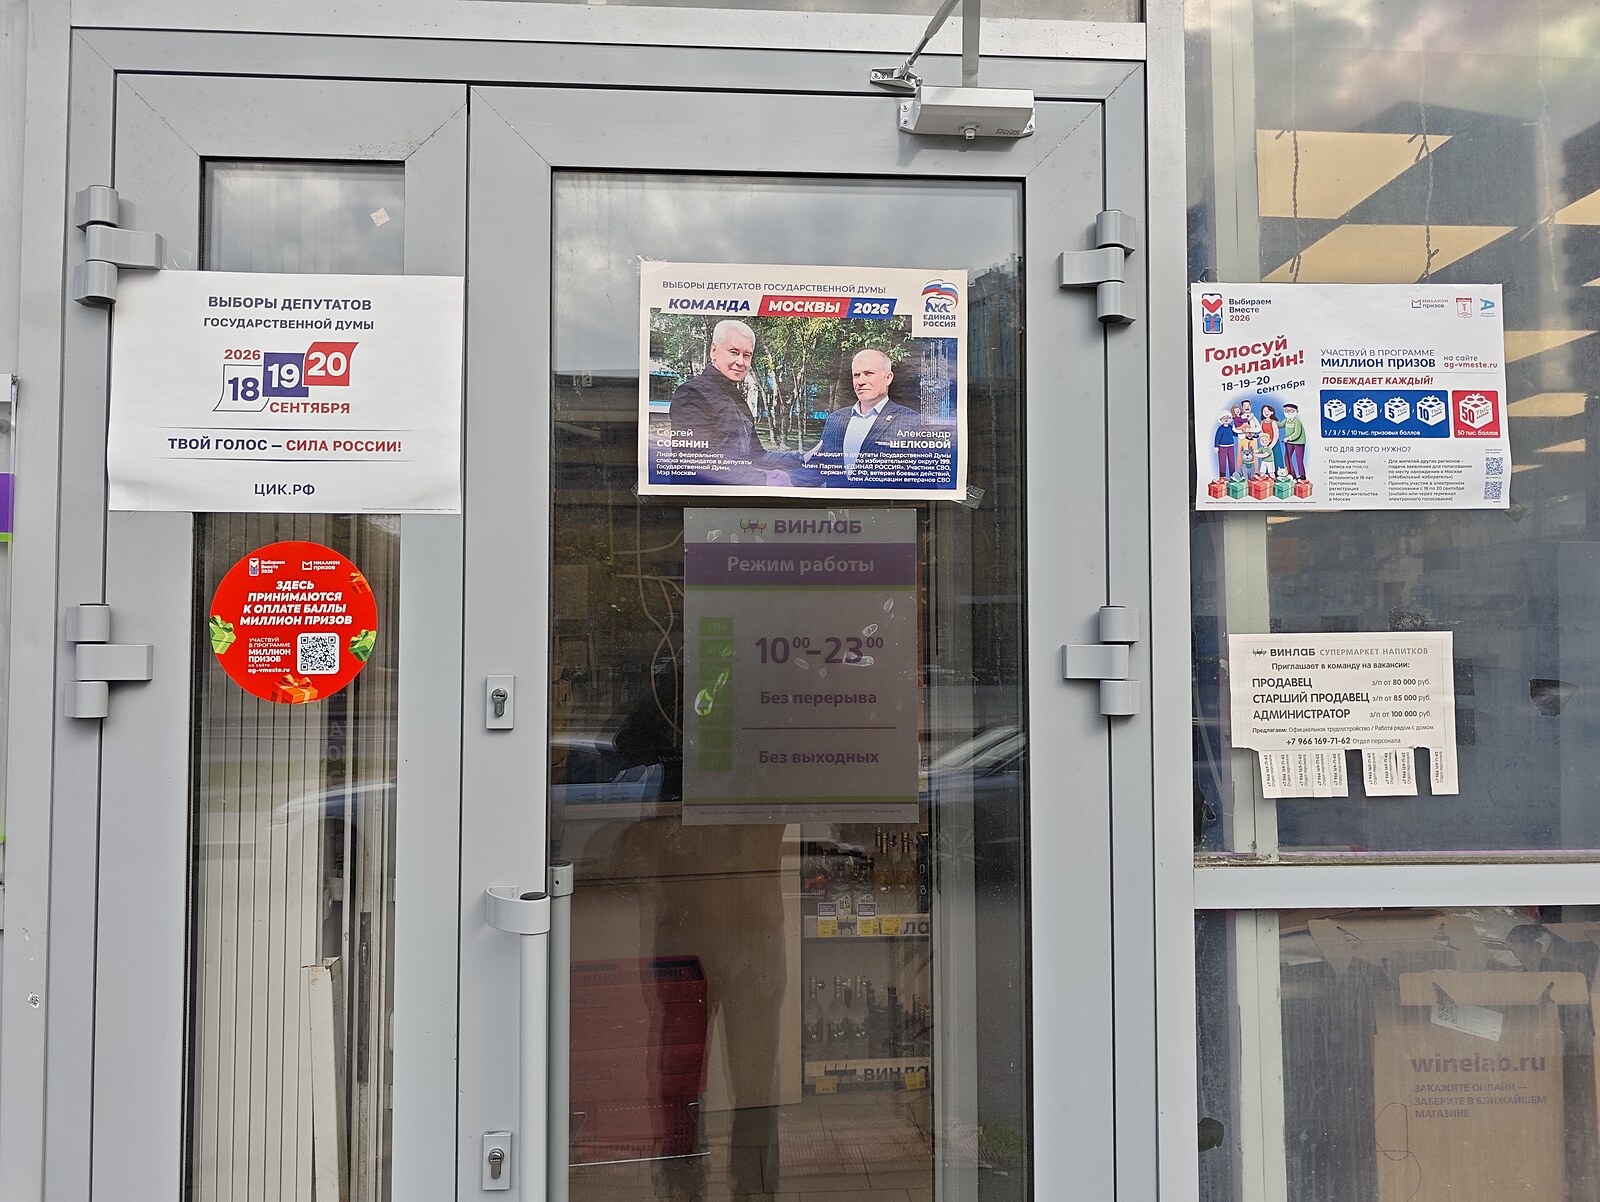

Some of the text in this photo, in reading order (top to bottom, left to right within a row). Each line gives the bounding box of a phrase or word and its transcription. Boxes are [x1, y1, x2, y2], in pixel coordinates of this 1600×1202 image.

[662, 281, 886, 294] ВЫБОРЫ ДЕПУТАТОВ ГОСУДАРСТВЕННОЙ ДУМЫ
[208, 296, 372, 312] ВЫБОРЫ ДЕПУТАТОВ
[668, 298, 890, 315] КОМАНДА МОСКВЫ 2026
[1228, 298, 1272, 306] Выбираем
[203, 317, 374, 331] ГОСУДАРСТВЕННОЙ ДУМЫ
[1229, 314, 1251, 322] 2026
[1204, 334, 1288, 363] Голосуй
[1320, 348, 1435, 357] УЧАСТВУЙ В ПРОГРАММЕ
[224, 349, 261, 361] 2026
[1221, 349, 1304, 377] онлайн!
[1387, 358, 1436, 370] призов
[1443, 361, 1498, 369] ag-vmeste.ru
[228, 352, 348, 402] 18 19 20
[1321, 375, 1434, 386] ПОБЕЖДАЕТ КАЖДЫЙ!
[1256, 379, 1306, 395] сентября
[269, 402, 350, 414] СЕНТЯБРЯ
[1356, 407, 1363, 419] 3
[1388, 407, 1395, 419] 5
[1418, 406, 1430, 421] 10
[1461, 405, 1475, 424] 50
[656, 428, 694, 437] Сергей
[896, 429, 951, 442] Александр
[168, 436, 402, 453] ТВОЙ ГОЛОС СИЛА РОССИИ!
[656, 439, 709, 449] СОБЯНИН
[889, 438, 951, 449] ШЕЛКОВОЙ
[933, 452, 952, 460] Думы
[656, 463, 711, 471] Государственной
[254, 483, 315, 497] ЦИК.РФ
[726, 555, 875, 576] Режим работы
[275, 580, 315, 591] ЗДЕСЬ
[247, 591, 343, 602] ПРИНИМАЮТСЯ
[243, 603, 347, 614] К ОПЛАТЕ БАЛЛЫ
[239, 615, 353, 626] МИЛЛИОН ПРИЗОВ
[1319, 648, 1380, 656] СУПЕРМАРКЕТ
[1382, 647, 1428, 655] НАПИТКОВ
[248, 655, 282, 664] призов
[1271, 662, 1319, 671] Приглашает
[1327, 663, 1361, 671] команду
[1252, 677, 1312, 689] ПРОДАВЕЦ
[1371, 679, 1383, 687] з/п
[1392, 678, 1402, 686] 80
[1402, 678, 1417, 686] 000
[1417, 679, 1431, 687] руб.
[760, 691, 878, 708] Без перерыва
[1252, 691, 1308, 704] СТАРШИЙ
[1310, 692, 1370, 704] ПРОДАВЕЦ
[1393, 694, 1403, 702] 85
[1418, 694, 1432, 702] руб.
[1253, 708, 1351, 721] АДМИНИСТРАТОР
[1391, 710, 1403, 718] 100
[1418, 710, 1433, 718] руб.
[1288, 726, 1326, 734] Официальное
[1286, 737, 1296, 745] +7
[1297, 737, 1313, 745] 966
[1314, 736, 1351, 745] 169-71-62
[1352, 737, 1370, 745] Отдел
[759, 751, 880, 767] Без выходных
[1411, 1052, 1546, 1073] winelab.ru
[1413, 1081, 1516, 1093] ЗАКАЖИТЕ ОНЛАЙН
[1414, 1097, 1465, 1106] ЗАБЕРИТЕ
[1476, 1094, 1547, 1105] БЛИЖАЙШЕМ
[1414, 1109, 1470, 1118] МАГАЗИНЕ
